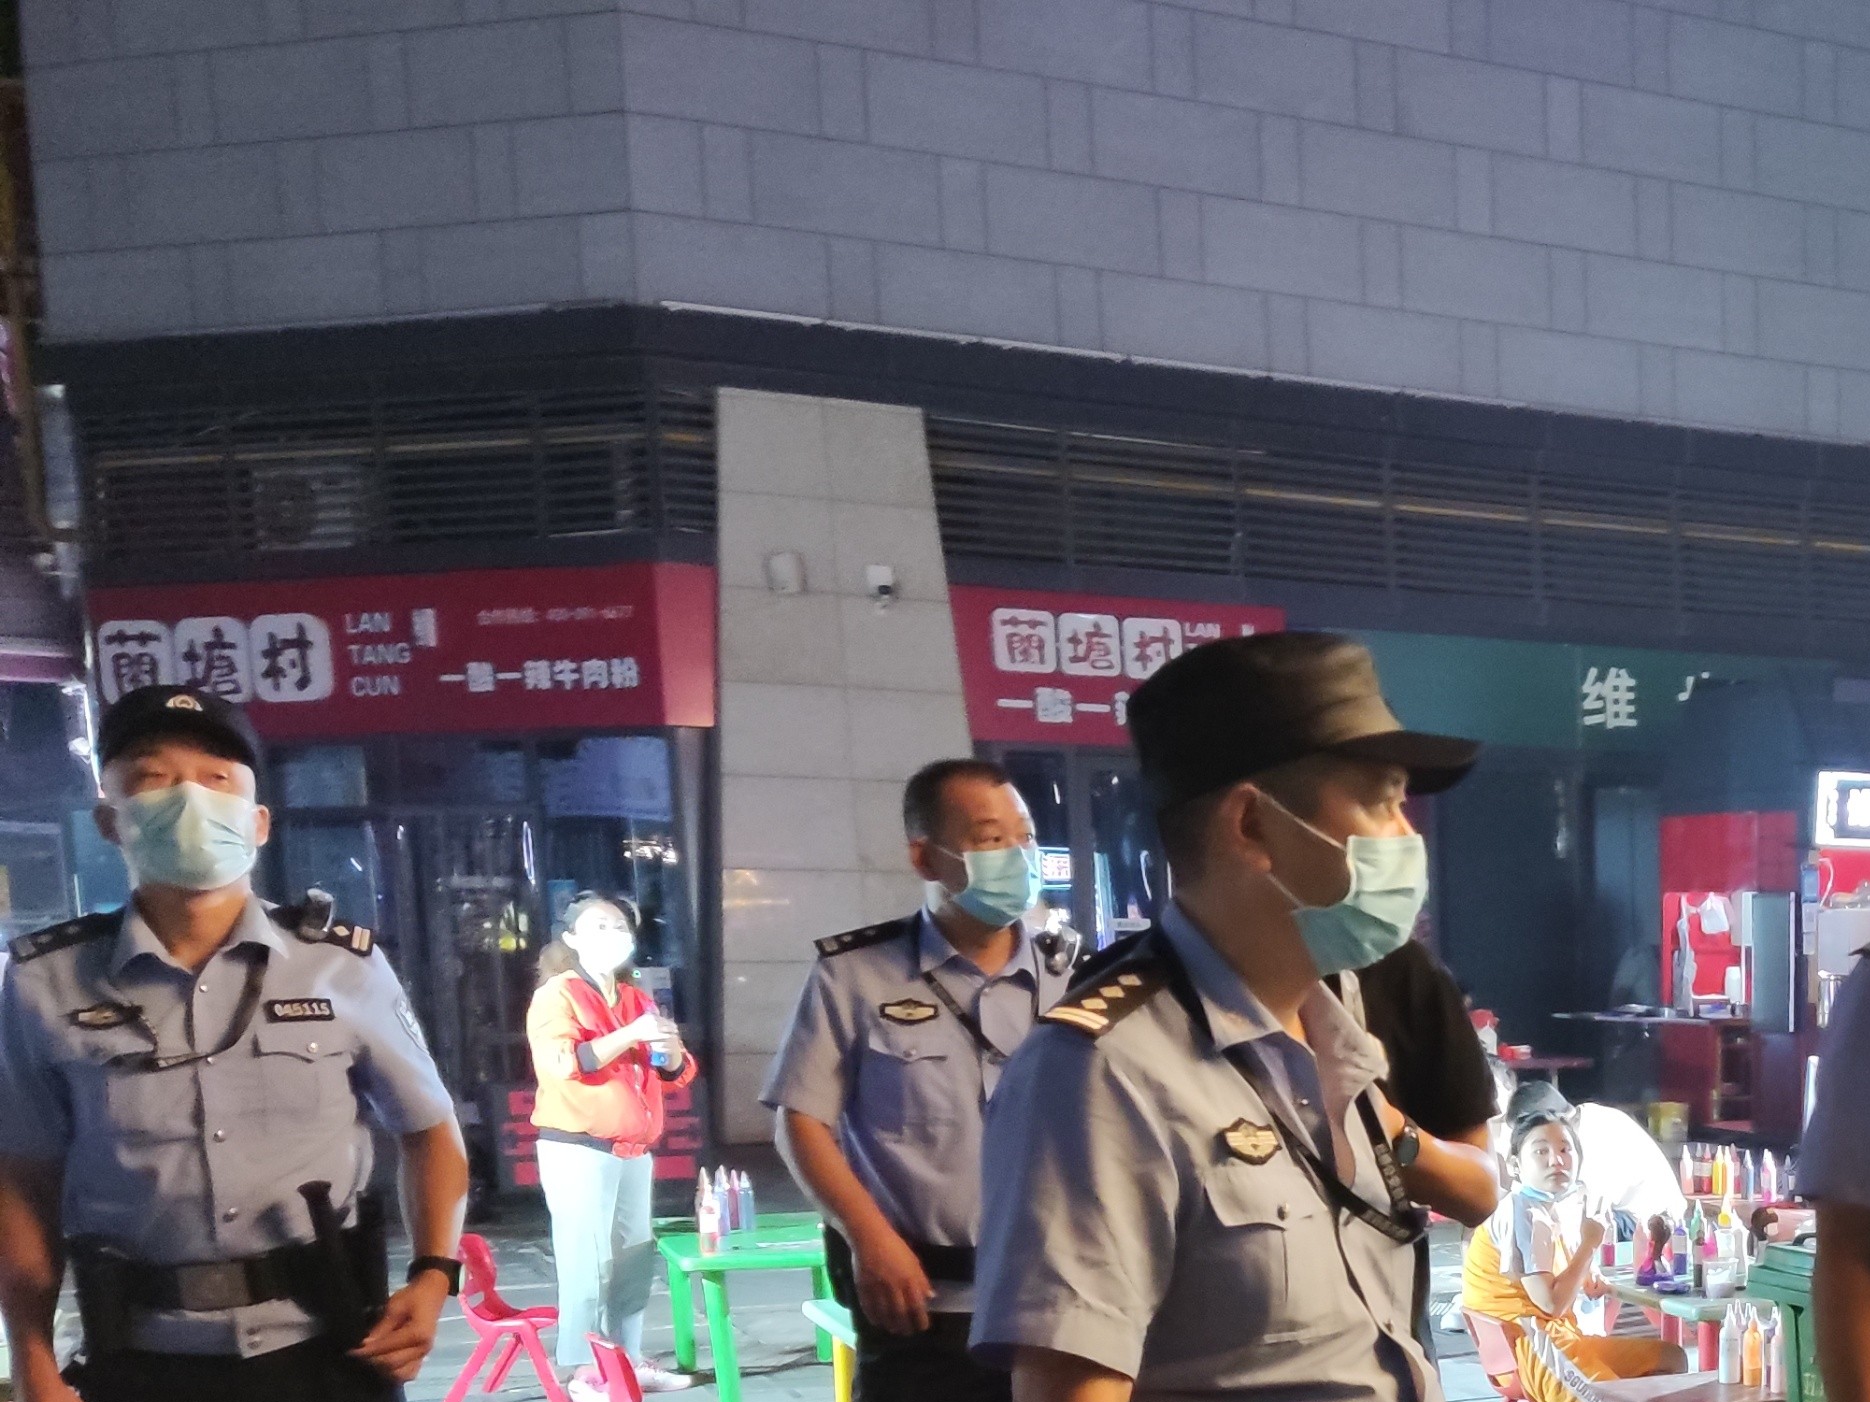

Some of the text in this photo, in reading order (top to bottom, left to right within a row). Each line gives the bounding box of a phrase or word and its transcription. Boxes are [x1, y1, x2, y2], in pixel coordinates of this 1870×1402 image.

[345, 612, 391, 634] LAN
[348, 643, 412, 666] TANG
[350, 675, 400, 697] CUN
